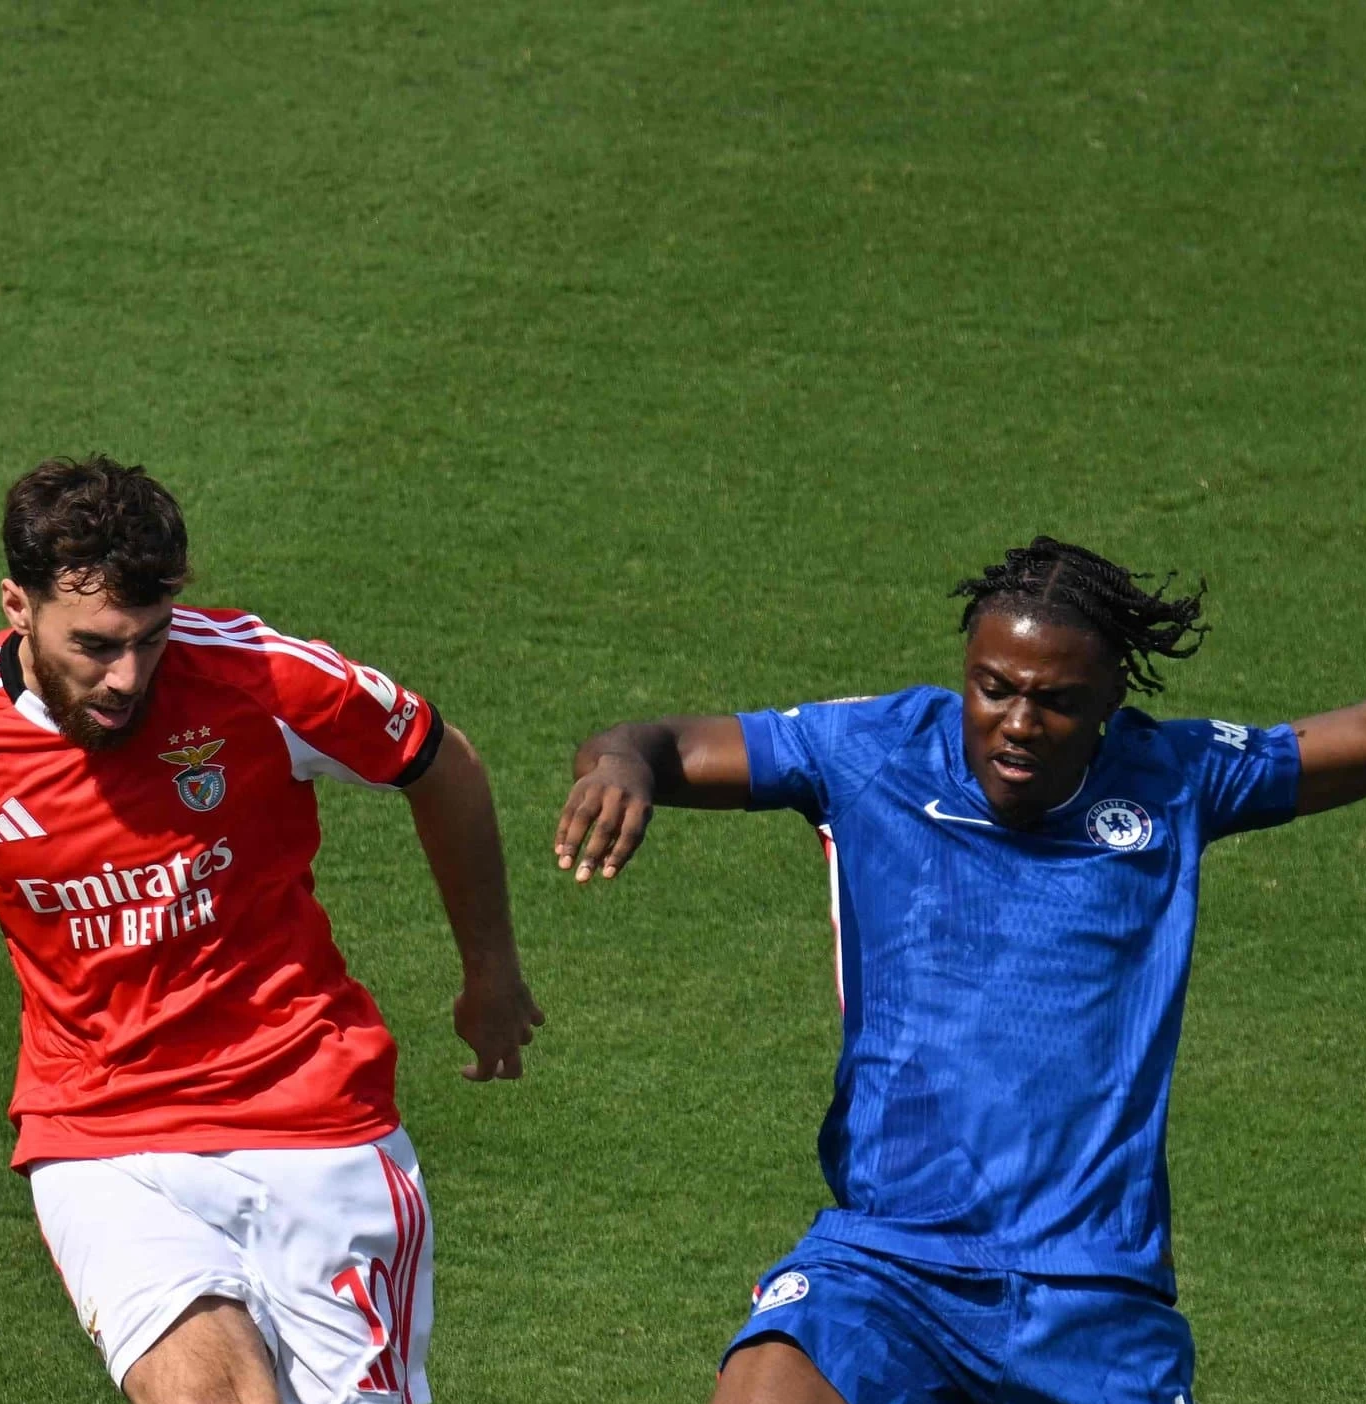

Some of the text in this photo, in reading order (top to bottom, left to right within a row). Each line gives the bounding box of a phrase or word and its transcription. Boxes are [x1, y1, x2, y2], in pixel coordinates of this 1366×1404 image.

[15, 836, 234, 914] Emirates
[69, 888, 217, 949] FLY BETTER
